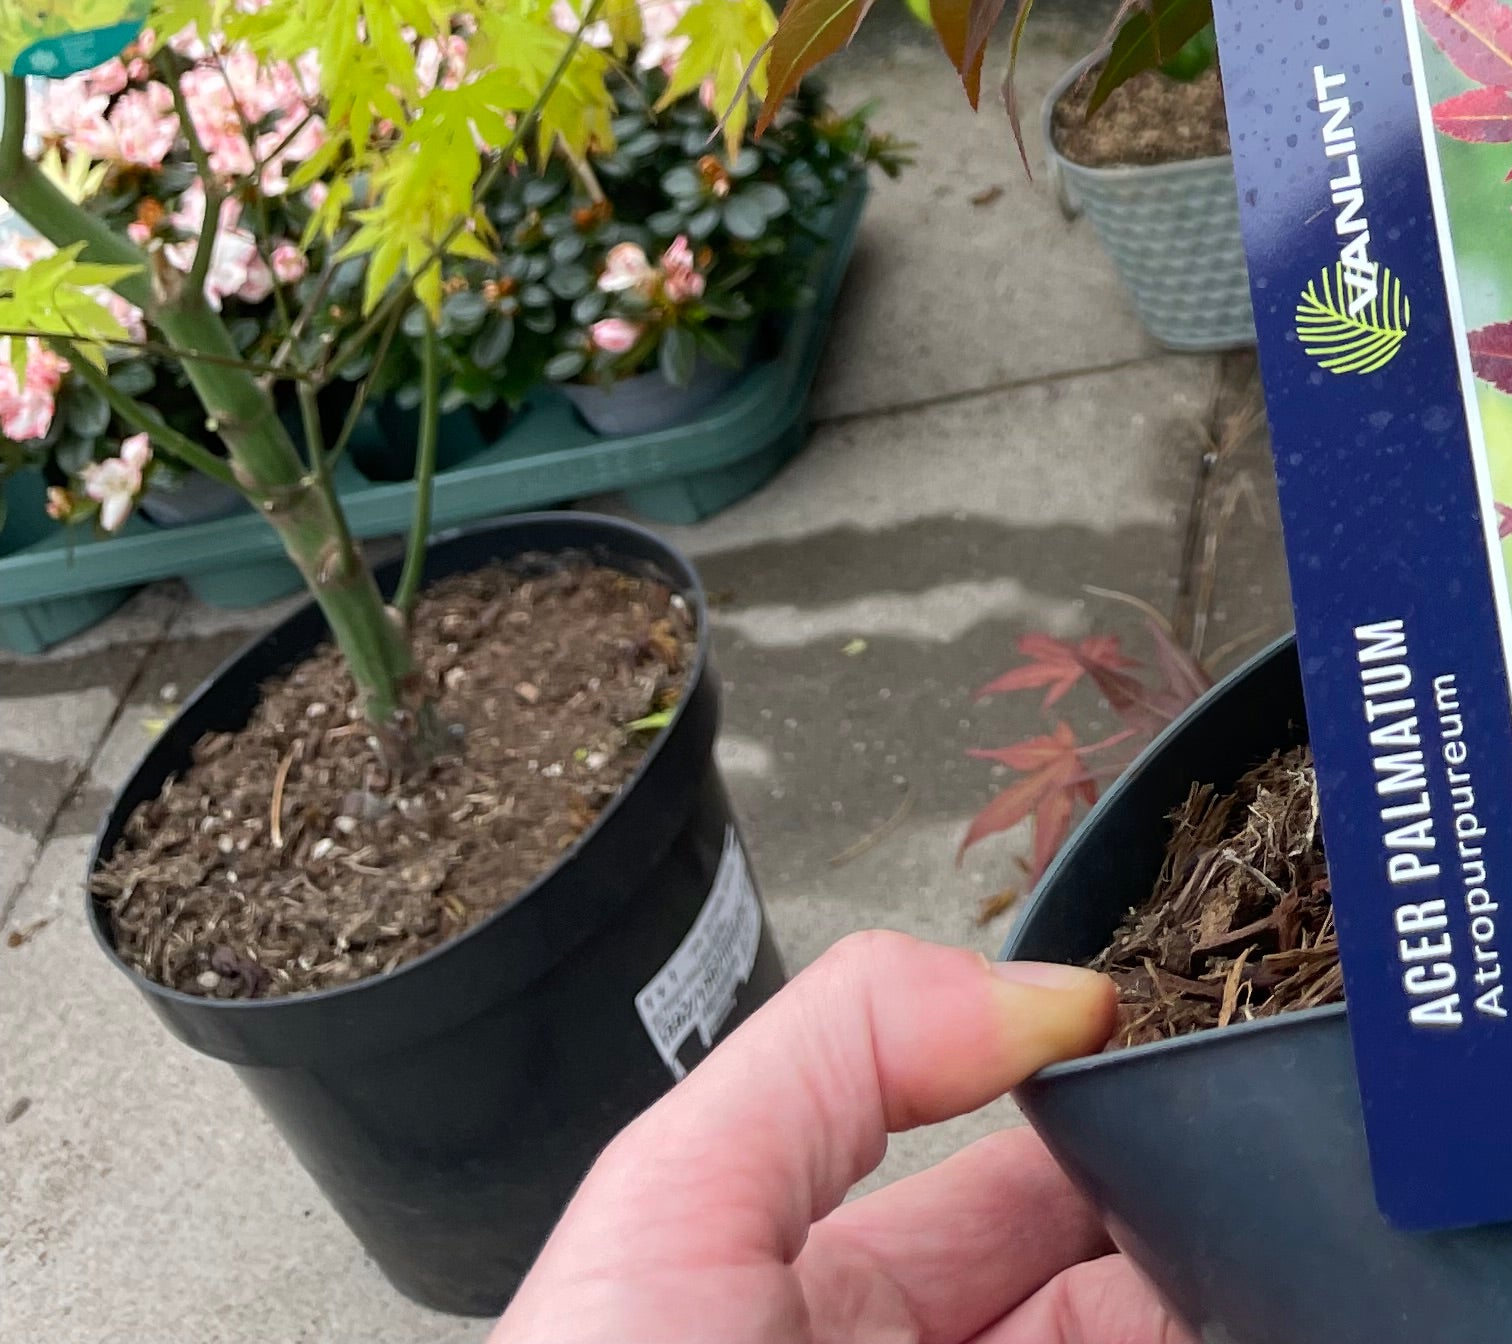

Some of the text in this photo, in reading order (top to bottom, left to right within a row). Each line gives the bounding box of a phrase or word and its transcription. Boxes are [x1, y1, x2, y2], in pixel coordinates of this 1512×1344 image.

[1313, 64, 1379, 318] VANLINT
[1354, 619, 1463, 1026] ACER PALMATUM
[1432, 673, 1509, 1018] Atropurpureum
